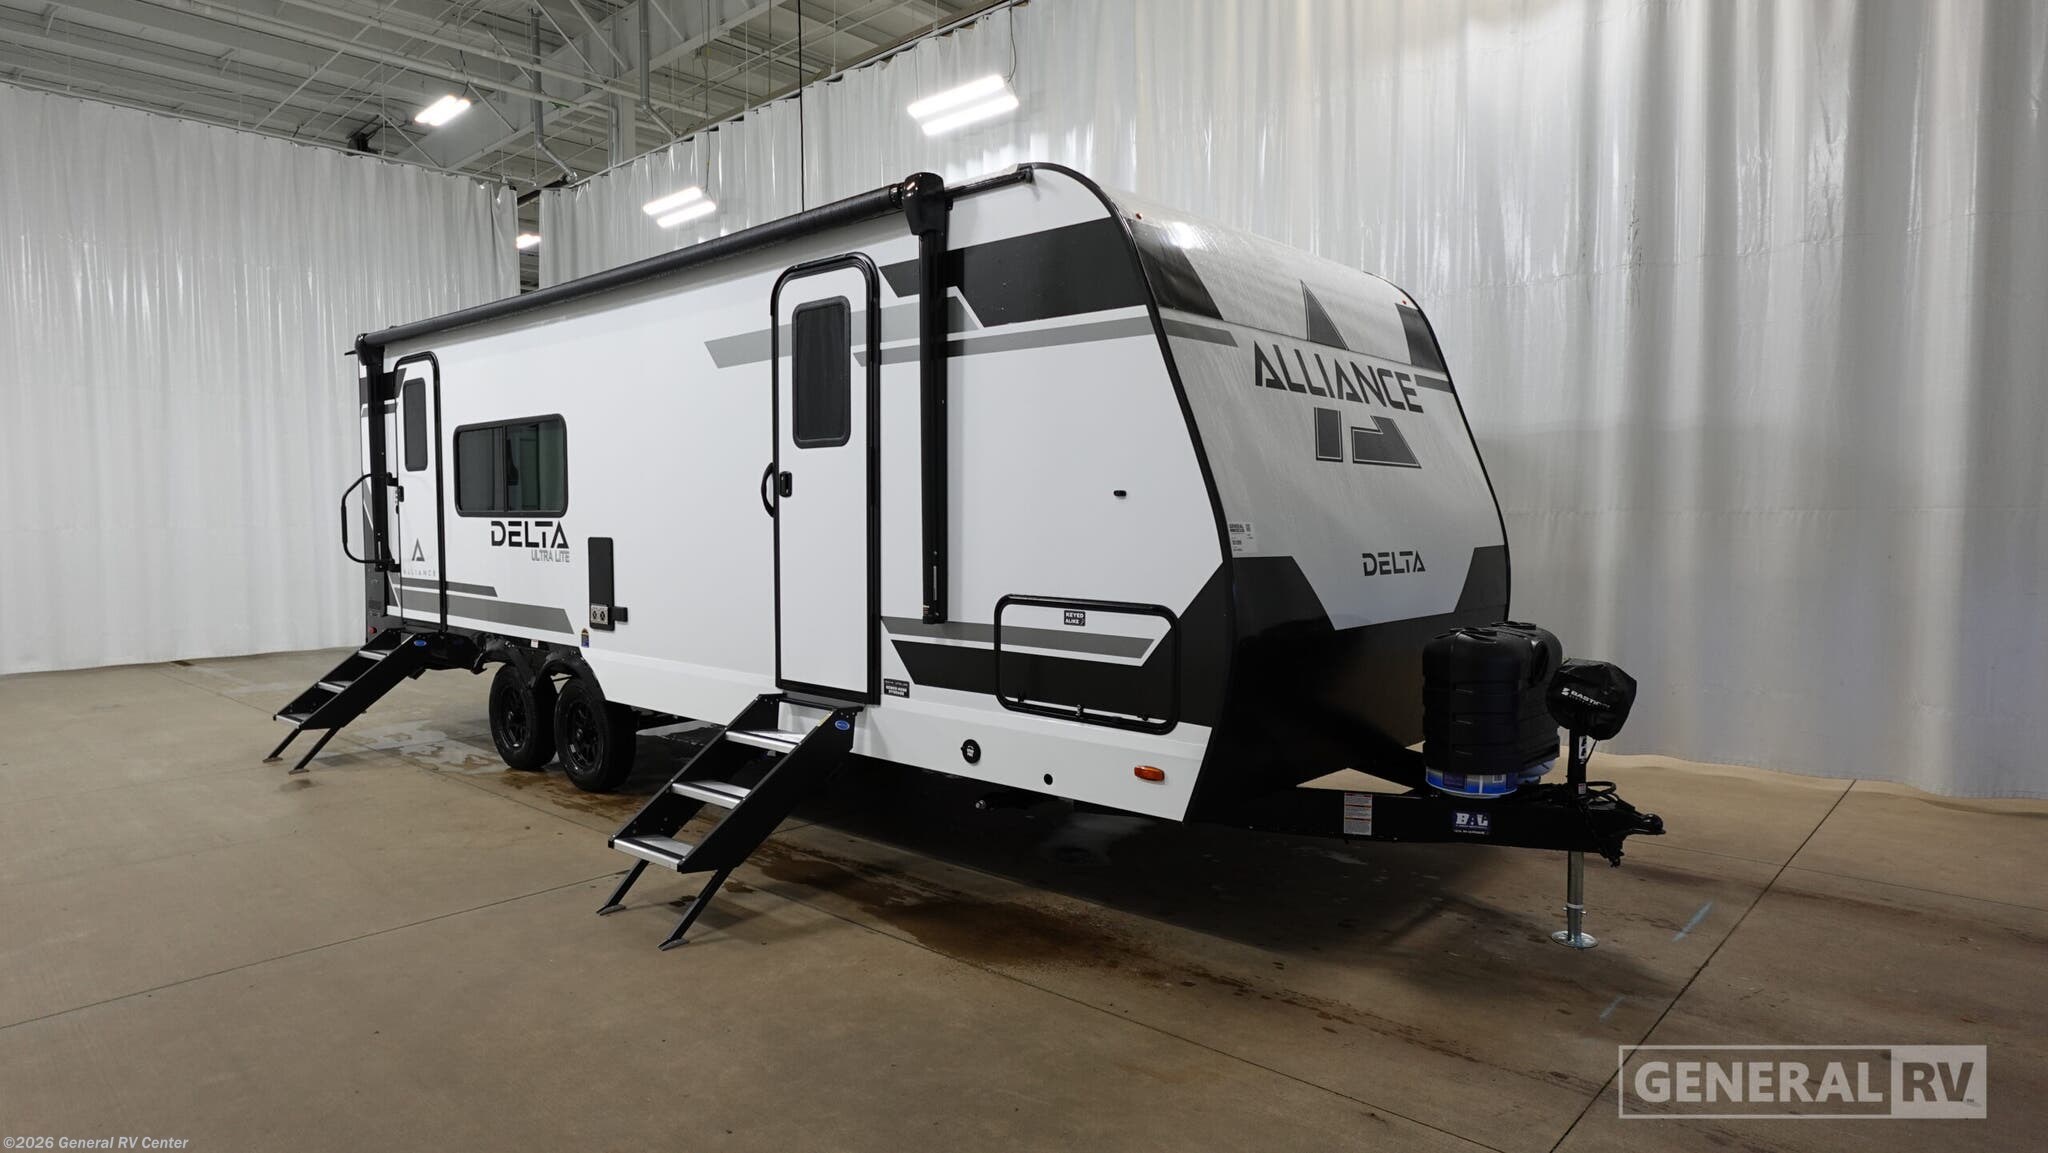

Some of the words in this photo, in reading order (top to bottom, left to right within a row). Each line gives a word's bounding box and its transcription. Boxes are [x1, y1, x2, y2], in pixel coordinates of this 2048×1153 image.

[1254, 340, 1424, 413] ALLIANCE
[490, 520, 569, 549] DELTA
[531, 549, 554, 562] ULTRA
[555, 550, 570, 563] LITE
[1362, 550, 1426, 576] DELTA
